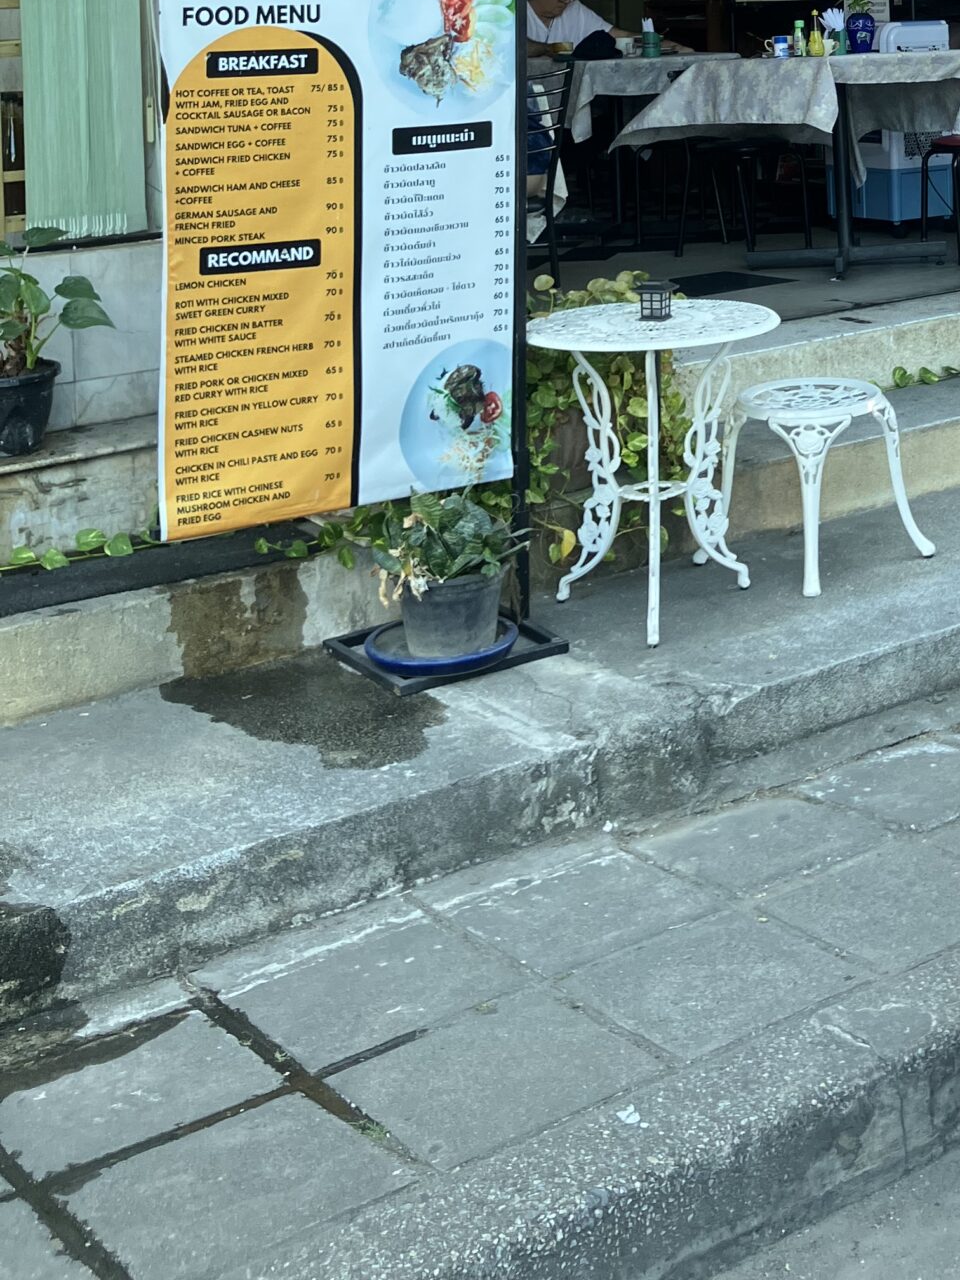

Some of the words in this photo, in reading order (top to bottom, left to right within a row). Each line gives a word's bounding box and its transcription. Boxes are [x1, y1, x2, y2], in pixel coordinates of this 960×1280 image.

[182, 6, 249, 25] FOOD
[255, 4, 320, 23] MENU
[218, 54, 308, 70] BREAKFAST
[196, 88, 229, 97] COFFEE
[231, 88, 244, 96] OR
[246, 87, 265, 95] TEA,
[266, 86, 294, 94] TOAST
[327, 83, 338, 91] 85
[201, 100, 222, 108] JAM,
[224, 99, 248, 107] FRIED
[250, 98, 268, 106] EGG
[270, 97, 289, 105] AND
[327, 104, 338, 112] 75
[175, 111, 221, 120] COCKTAIL
[223, 109, 263, 118] SAUSAGE
[265, 108, 278, 116] OR
[280, 107, 310, 115] BACON
[175, 126, 225, 134] SANDWICH
[227, 124, 251, 132] TUNA
[260, 122, 291, 130] COFFEE
[327, 119, 337, 127] 75
[175, 142, 224, 151] SANDWICH
[227, 140, 245, 148] EGG
[254, 138, 285, 147] COFFEE
[327, 134, 337, 142] 75
[412, 128, 475, 148] เมนูแนะนำ
[175, 156, 224, 165] SANDWICH
[226, 155, 250, 163] FRIED
[252, 152, 290, 161] CHICKEN
[327, 150, 337, 158] 75
[495, 154, 504, 162] 65
[182, 168, 215, 176] COFFEE
[174, 184, 224, 194] SANDWICH
[226, 183, 247, 191] HAM
[248, 182, 268, 190] AND
[269, 179, 300, 188] CHEESE
[326, 176, 337, 184] 85
[326, 202, 337, 210] 90
[174, 211, 213, 220] GERMAN
[215, 208, 256, 217] SAUSAGE
[258, 206, 277, 214] AND
[174, 222, 209, 230] FRENCH
[211, 220, 235, 228] FRIED
[325, 226, 337, 234] 90
[174, 236, 208, 244] MINCED
[210, 234, 236, 242] PORK
[238, 232, 265, 241] STEAK
[175, 281, 204, 291] LEMON
[206, 278, 246, 288] CHICKEN
[175, 300, 194, 309] ROTI
[195, 298, 219, 306] WITH
[221, 295, 260, 304] CHICKEN
[262, 292, 289, 301] MIXED
[175, 310, 202, 320] SWEET
[204, 308, 234, 317] GREEN
[235, 305, 265, 314] CURRY
[174, 327, 197, 336] FRIED
[199, 323, 238, 333] CHICKEN
[251, 319, 283, 328] BATTER
[174, 338, 196, 347] WITH
[198, 335, 225, 344] WHITE
[228, 332, 256, 342] SAUCE
[174, 352, 213, 364] STEAMED
[215, 348, 254, 359] CHICKEN
[256, 345, 290, 354] FRENCH
[292, 342, 313, 351] HERB
[174, 366, 196, 375] WITH
[198, 363, 218, 372] RICE
[174, 382, 198, 391] FRIED
[199, 378, 224, 388] PORK
[226, 377, 239, 385] OR
[241, 373, 279, 383] CHICKEN
[281, 369, 308, 378] MIXED
[174, 394, 191, 402] RED
[192, 390, 222, 400] CURRY
[224, 387, 247, 396] WITH
[249, 385, 268, 393] RICE
[174, 410, 198, 419] FRIED
[200, 405, 238, 416] CHICKEN
[241, 403, 250, 411] IN
[252, 399, 288, 409] YELLOW
[289, 396, 318, 405] CURRY
[174, 421, 197, 430] WITH
[199, 418, 218, 427] RICE
[174, 437, 198, 447] FRIED
[200, 432, 239, 443] CHICKEN
[241, 427, 278, 438] CASHEW
[280, 424, 303, 433] NUTS
[174, 448, 197, 458] WITH
[199, 445, 218, 454] RICE
[175, 462, 214, 474] CHICKEN
[216, 461, 225, 469] IN
[227, 458, 249, 467] CHILI
[251, 454, 277, 464] PASTE
[279, 451, 298, 460] AND
[300, 449, 318, 458] EGG
[175, 476, 198, 485] WITH
[200, 473, 219, 482] RICE
[176, 493, 200, 502] FRIED
[202, 490, 221, 499] RICE
[223, 486, 246, 496] WITH
[248, 481, 283, 492] CHINESE
[177, 500, 230, 513] MUSHROOM
[232, 495, 270, 506] CHICKEN
[271, 491, 290, 500] AND
[177, 516, 201, 526] FRIED
[203, 512, 221, 522] EGG
